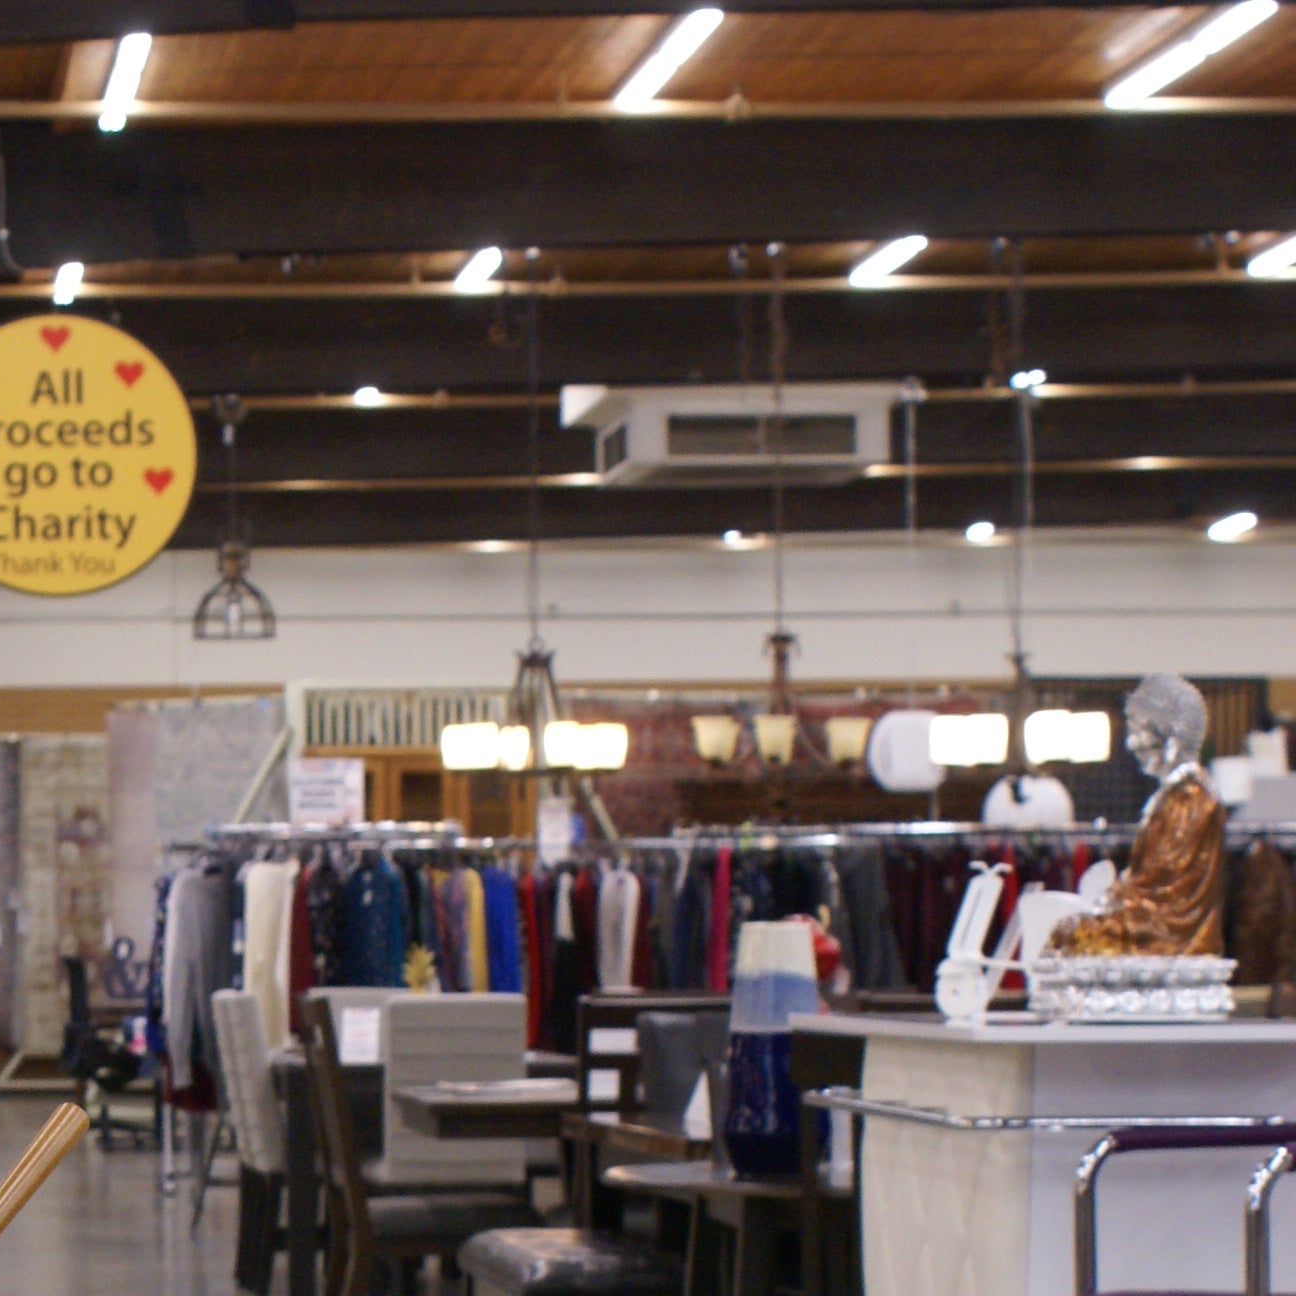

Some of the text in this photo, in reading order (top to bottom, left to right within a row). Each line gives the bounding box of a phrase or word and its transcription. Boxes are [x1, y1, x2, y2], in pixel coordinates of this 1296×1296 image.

[31, 369, 84, 405] All
[4, 458, 113, 497] go to
[73, 553, 116, 574] You
